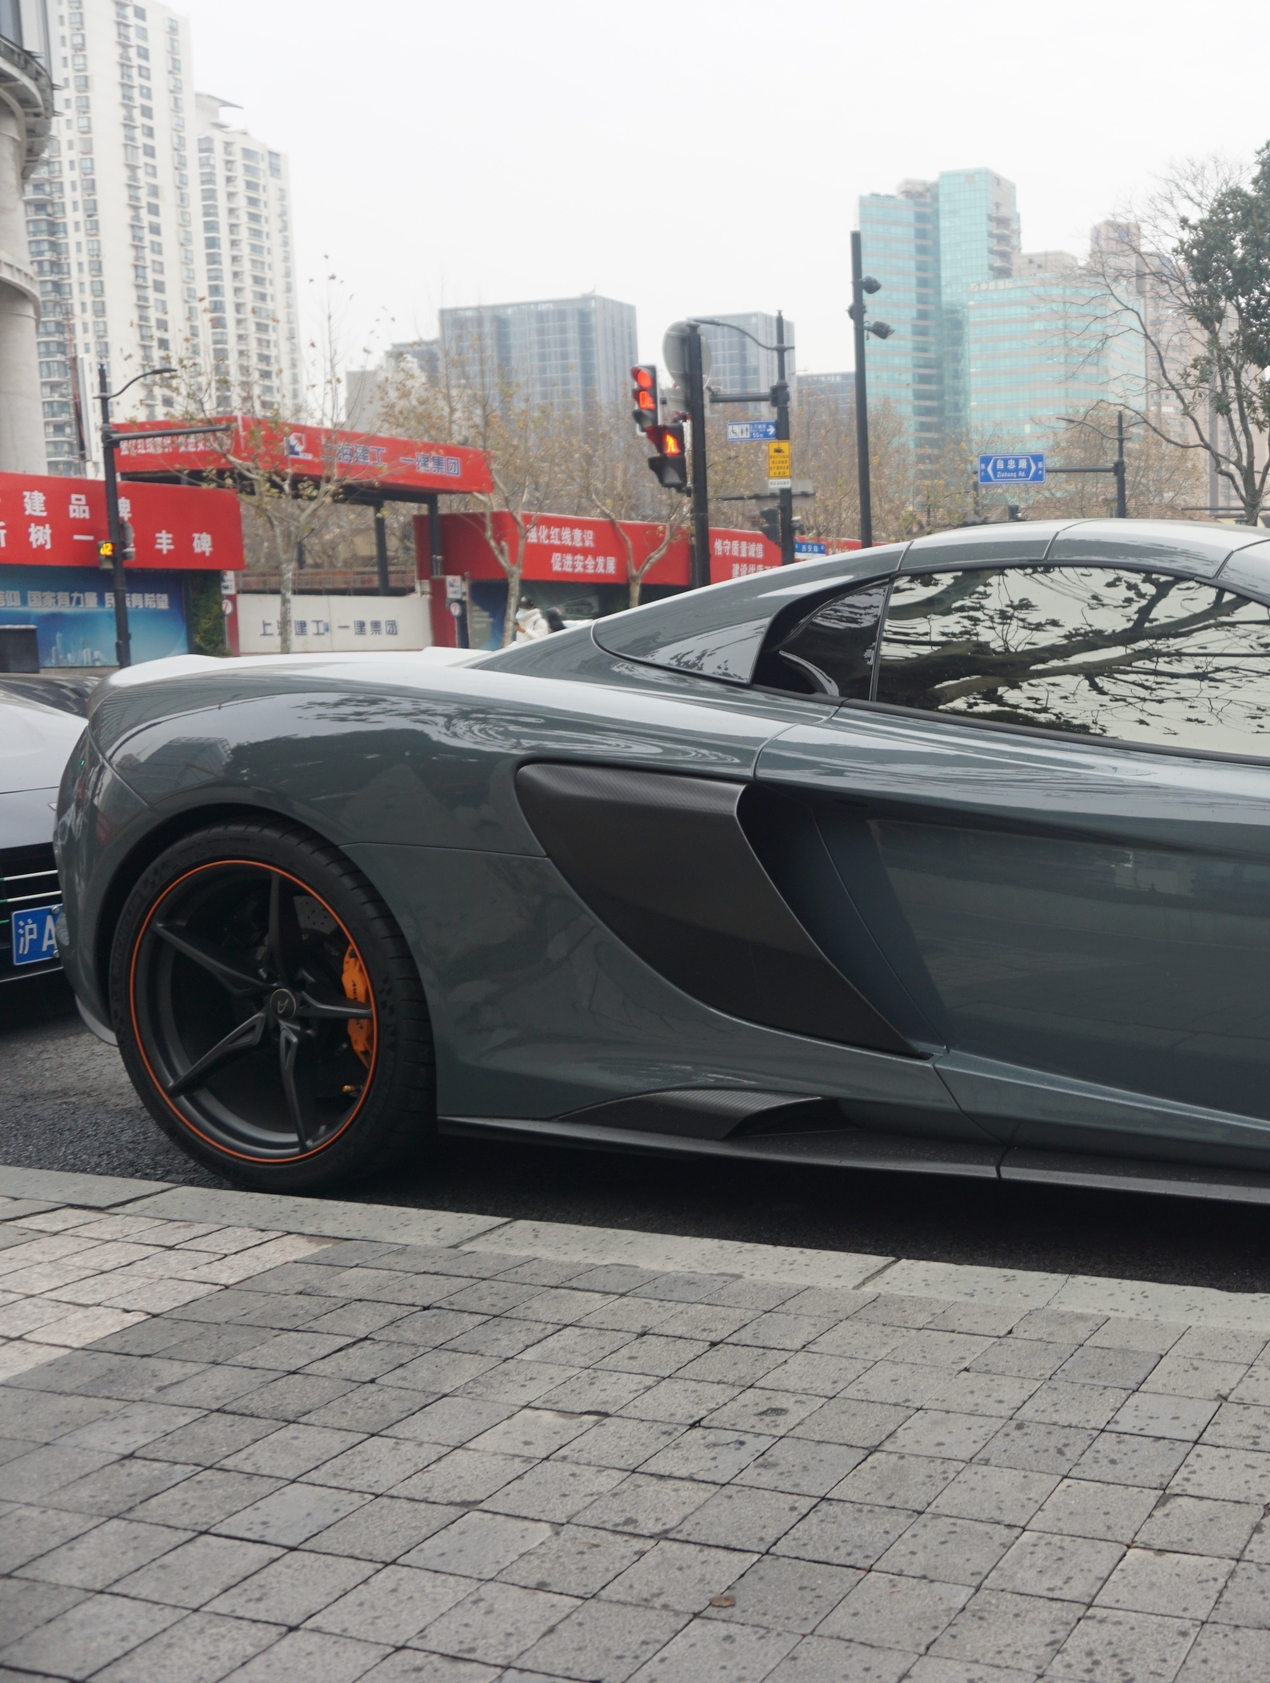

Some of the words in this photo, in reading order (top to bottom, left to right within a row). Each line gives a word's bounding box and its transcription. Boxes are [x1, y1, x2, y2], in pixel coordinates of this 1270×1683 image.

[399, 452, 461, 477] 一建集团
[996, 458, 1028, 469] 自忠路
[0, 521, 213, 556] 树一丰碑
[526, 524, 595, 547] 强化红线意识
[714, 538, 764, 559] 恪守质量诚信
[551, 552, 617, 575] 促进安全发展
[27, 591, 98, 608] 国家有力量
[337, 619, 398, 636] 一建集团
